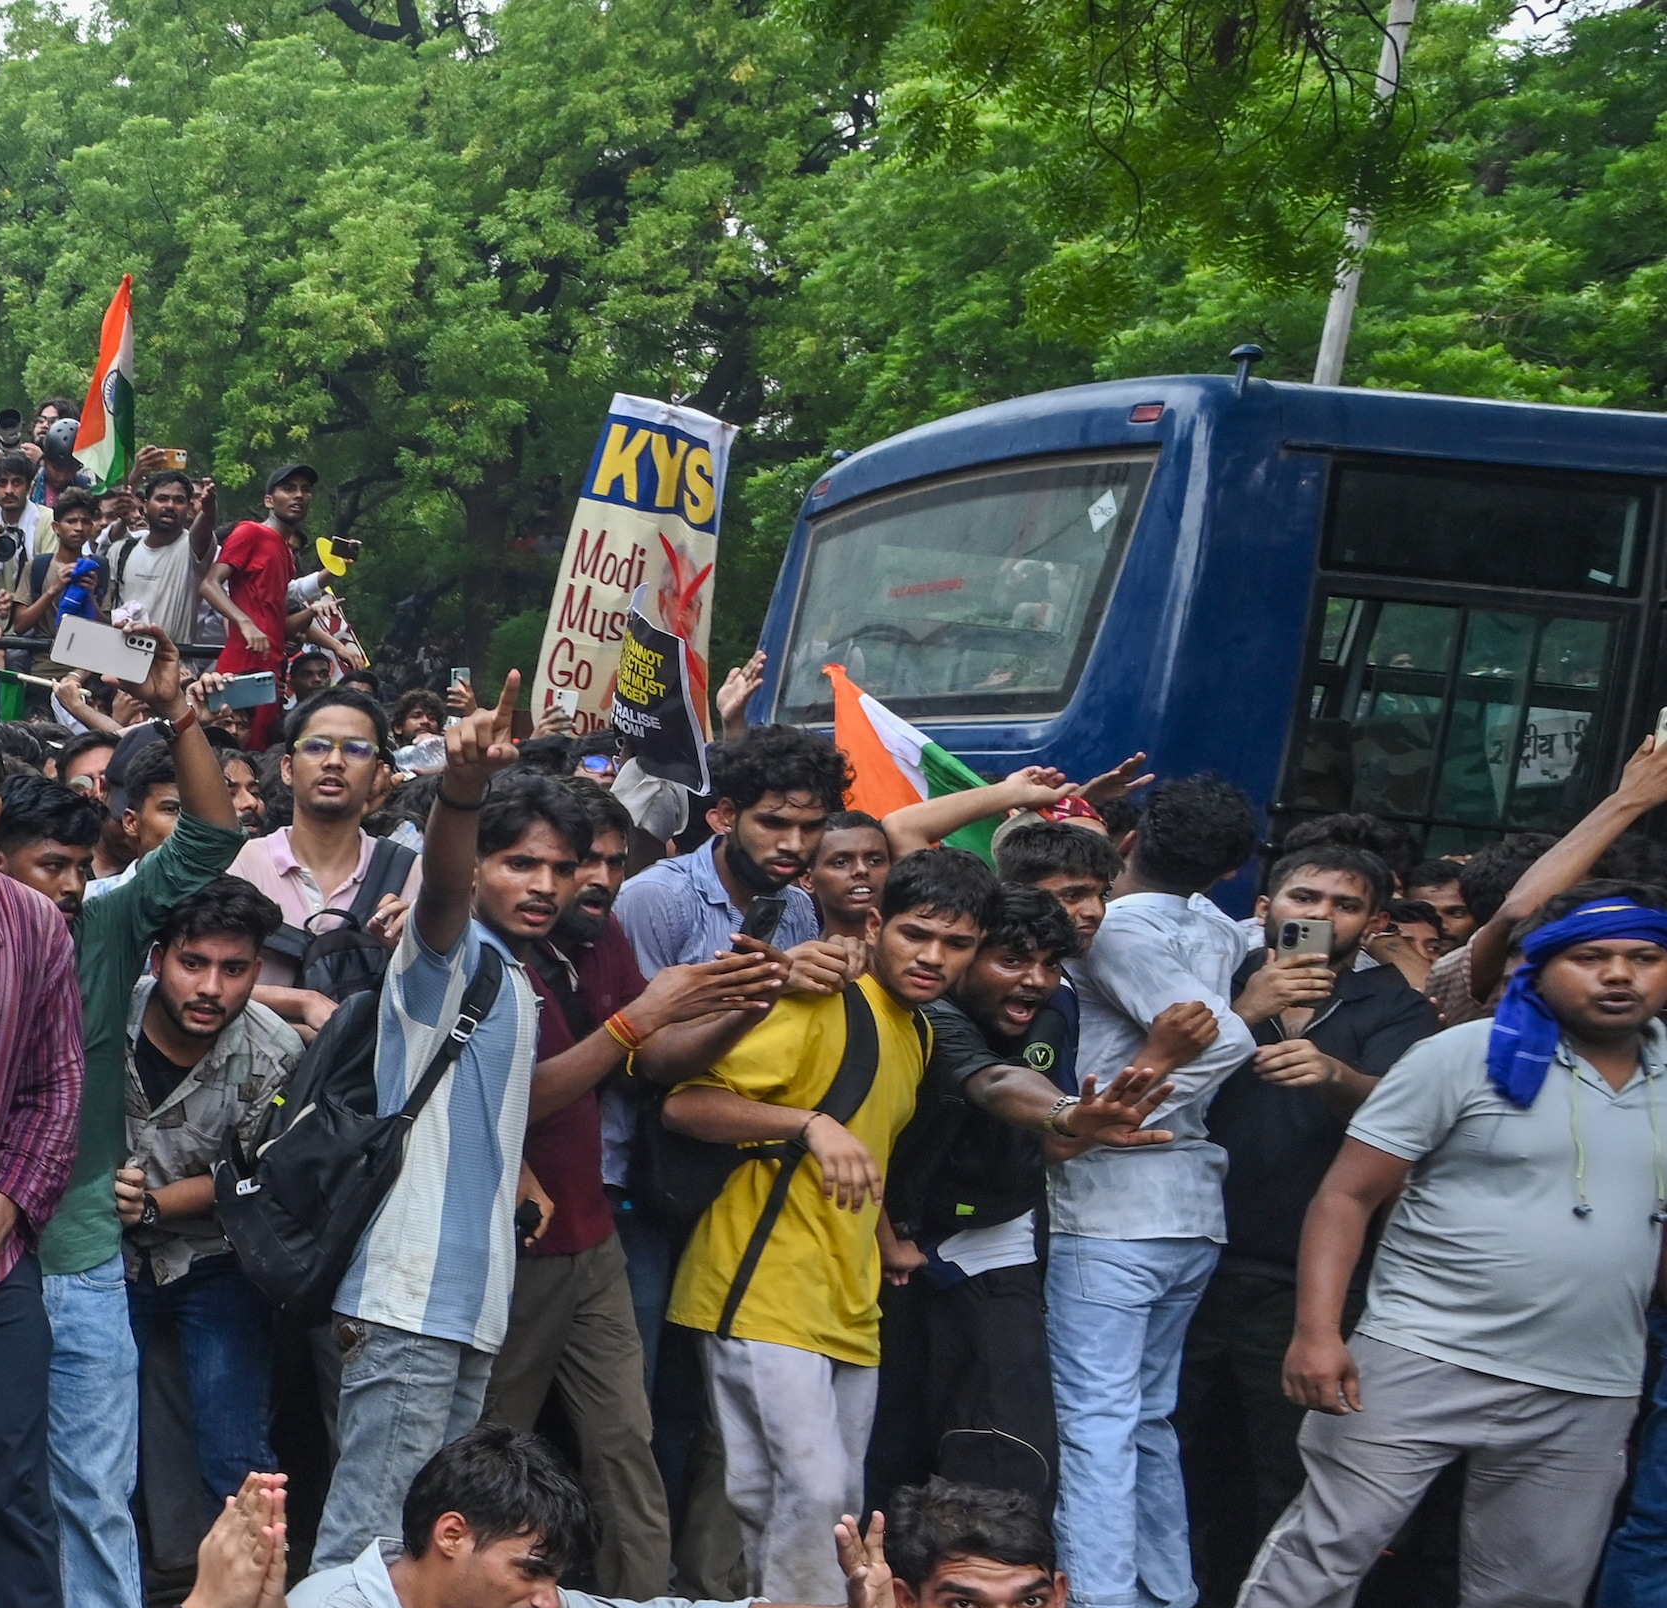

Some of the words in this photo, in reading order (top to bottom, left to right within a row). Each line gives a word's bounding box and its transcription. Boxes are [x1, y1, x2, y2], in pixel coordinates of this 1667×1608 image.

[592, 424, 715, 525] KYS
[1093, 506, 1113, 517] CNG
[571, 529, 646, 593] Modi
[557, 583, 628, 642] Mus
[548, 637, 593, 690] Go
